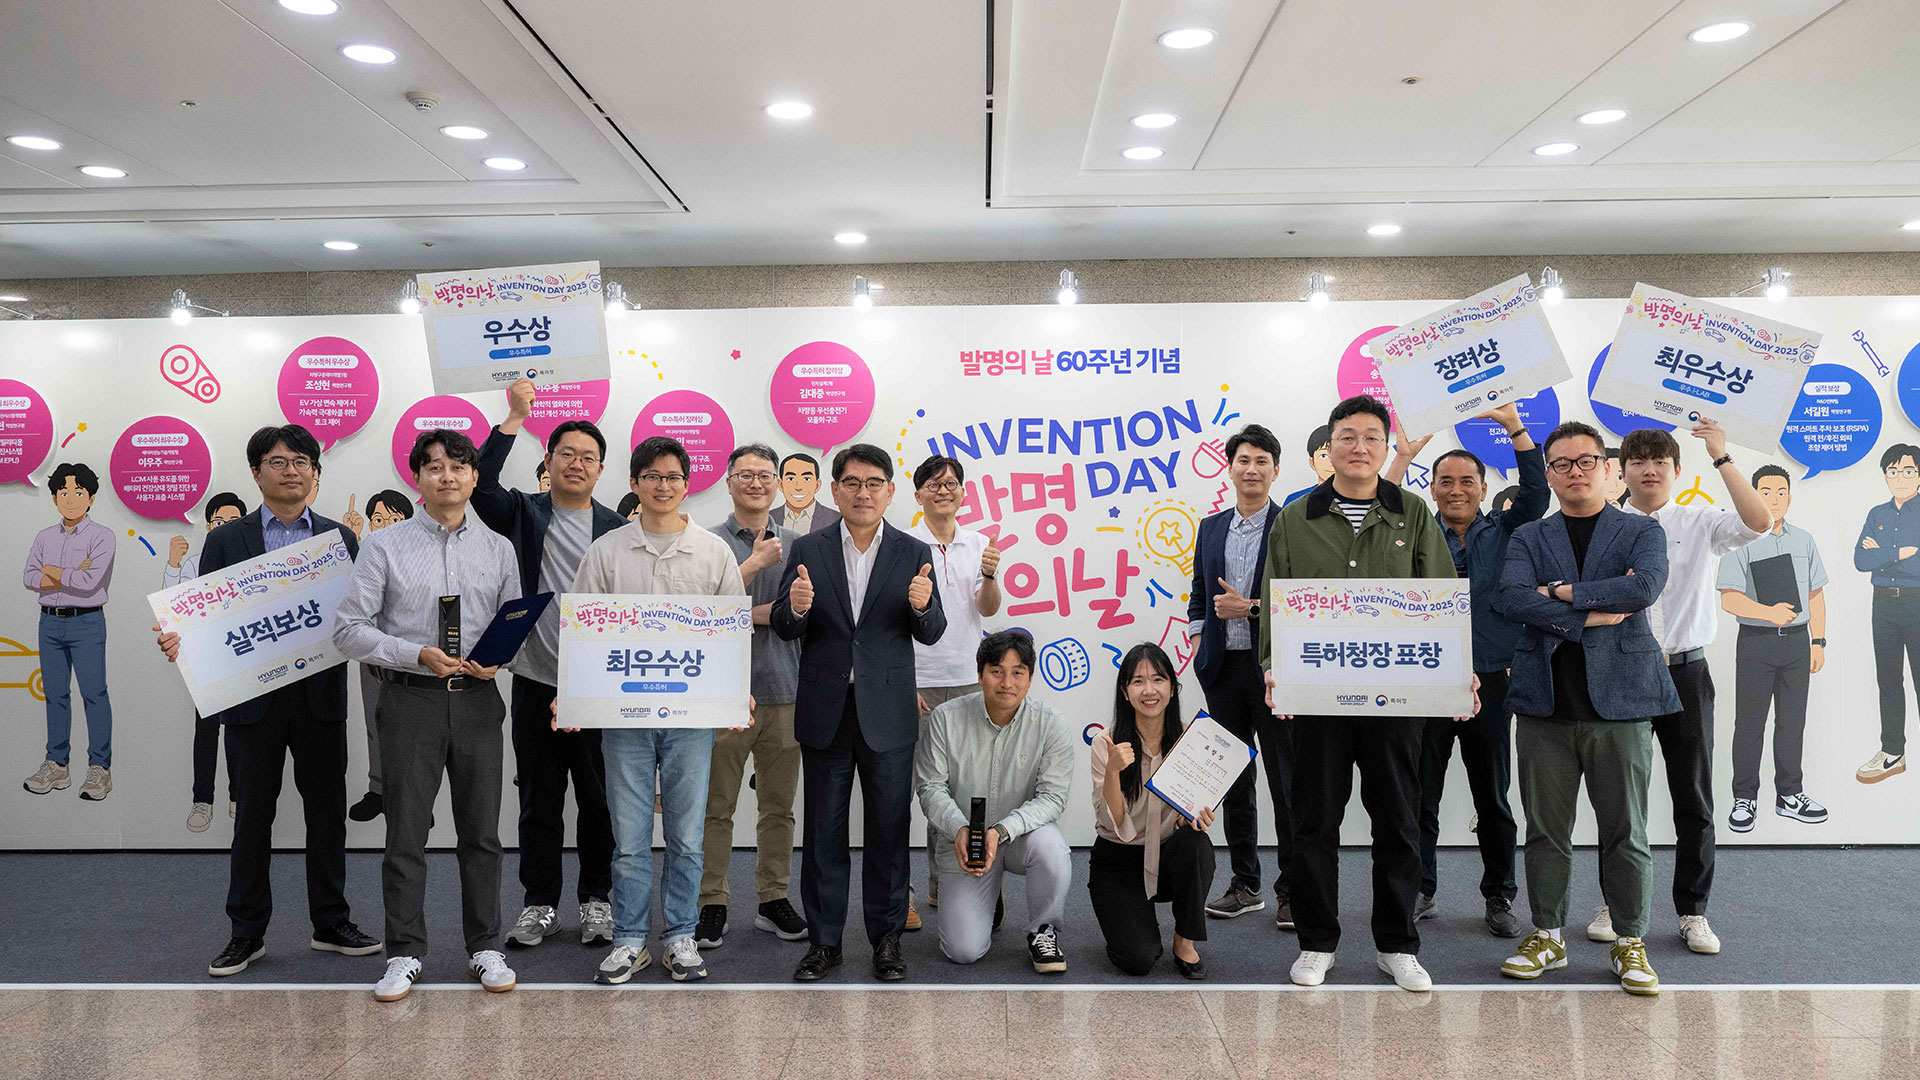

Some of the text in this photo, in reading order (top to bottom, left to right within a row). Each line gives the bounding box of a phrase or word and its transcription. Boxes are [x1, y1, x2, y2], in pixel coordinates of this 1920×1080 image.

[435, 282, 587, 303] 발명의날 INVENTION DAY 2025
[483, 316, 551, 344] 우수상
[1386, 296, 1522, 357] 발명의날 INVENTION DAY 2025
[1644, 302, 1798, 356] 발명의날 INVENTION DAY 2025
[960, 348, 1180, 376] 발명의 날 60주년 기념
[1434, 338, 1500, 380] 장려상
[1654, 346, 1754, 394] 최우수상
[305, 380, 330, 390] 조성현
[800, 388, 824, 399] 김대중
[571, 400, 582, 408] 의한
[1654, 400, 1683, 412] HYUNDAI
[1804, 406, 1829, 417] 서길원
[927, 399, 1202, 460] INVENTION
[138, 458, 162, 467] 이우주
[1086, 450, 1181, 498] DAY
[171, 554, 333, 616] 발명의날 INVENTION DAY 2025
[1003, 548, 1140, 630] 의날
[1287, 593, 1453, 612] 발명의날 INVENTION DAY 2025
[224, 600, 323, 656] 실적보상
[576, 607, 736, 627] 발명의날 INVENTION DAY 2025
[606, 649, 705, 677] 최우수상
[1300, 642, 1442, 669] 특허청장 표창
[257, 665, 288, 681] HYUNDAI
[642, 683, 667, 691] 우수특허
